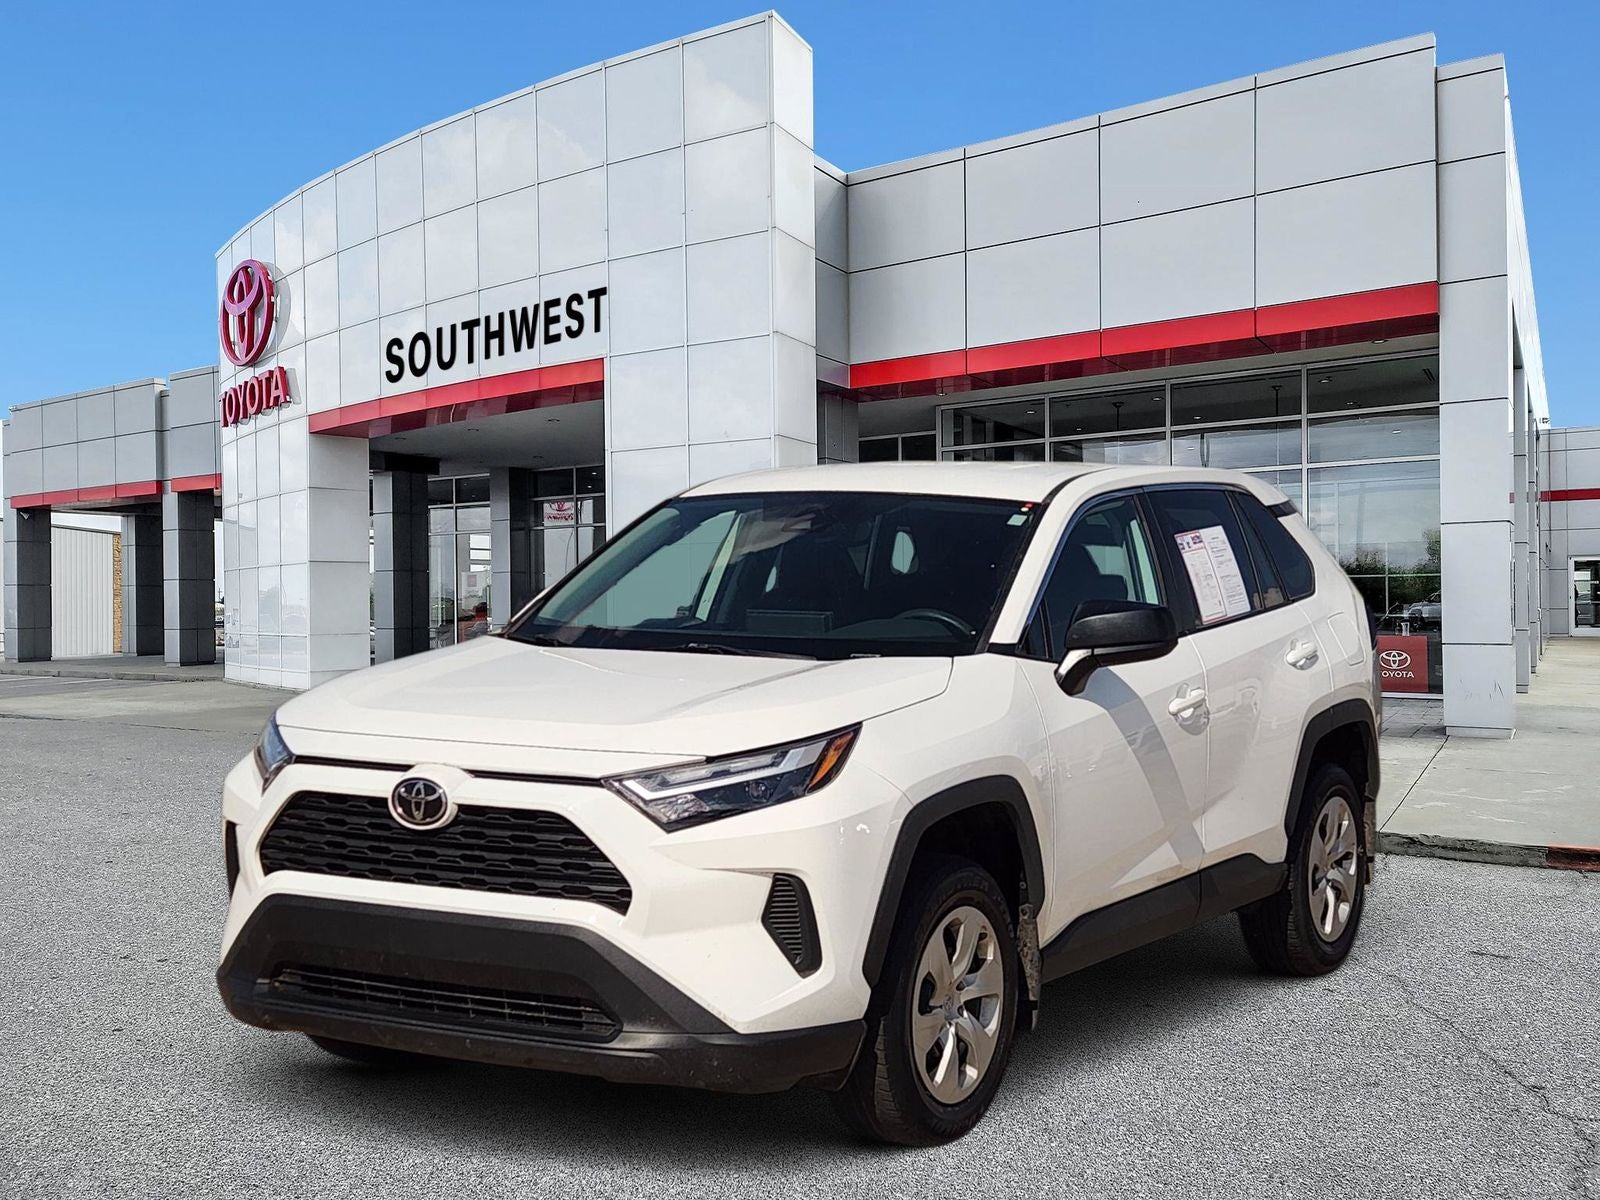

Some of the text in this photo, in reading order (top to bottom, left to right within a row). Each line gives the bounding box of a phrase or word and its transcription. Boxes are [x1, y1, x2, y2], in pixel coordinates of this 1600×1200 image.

[385, 286, 607, 383] SOUTHWEST
[219, 366, 290, 428] TOYOTA
[1380, 670, 1414, 678] OYOTA
